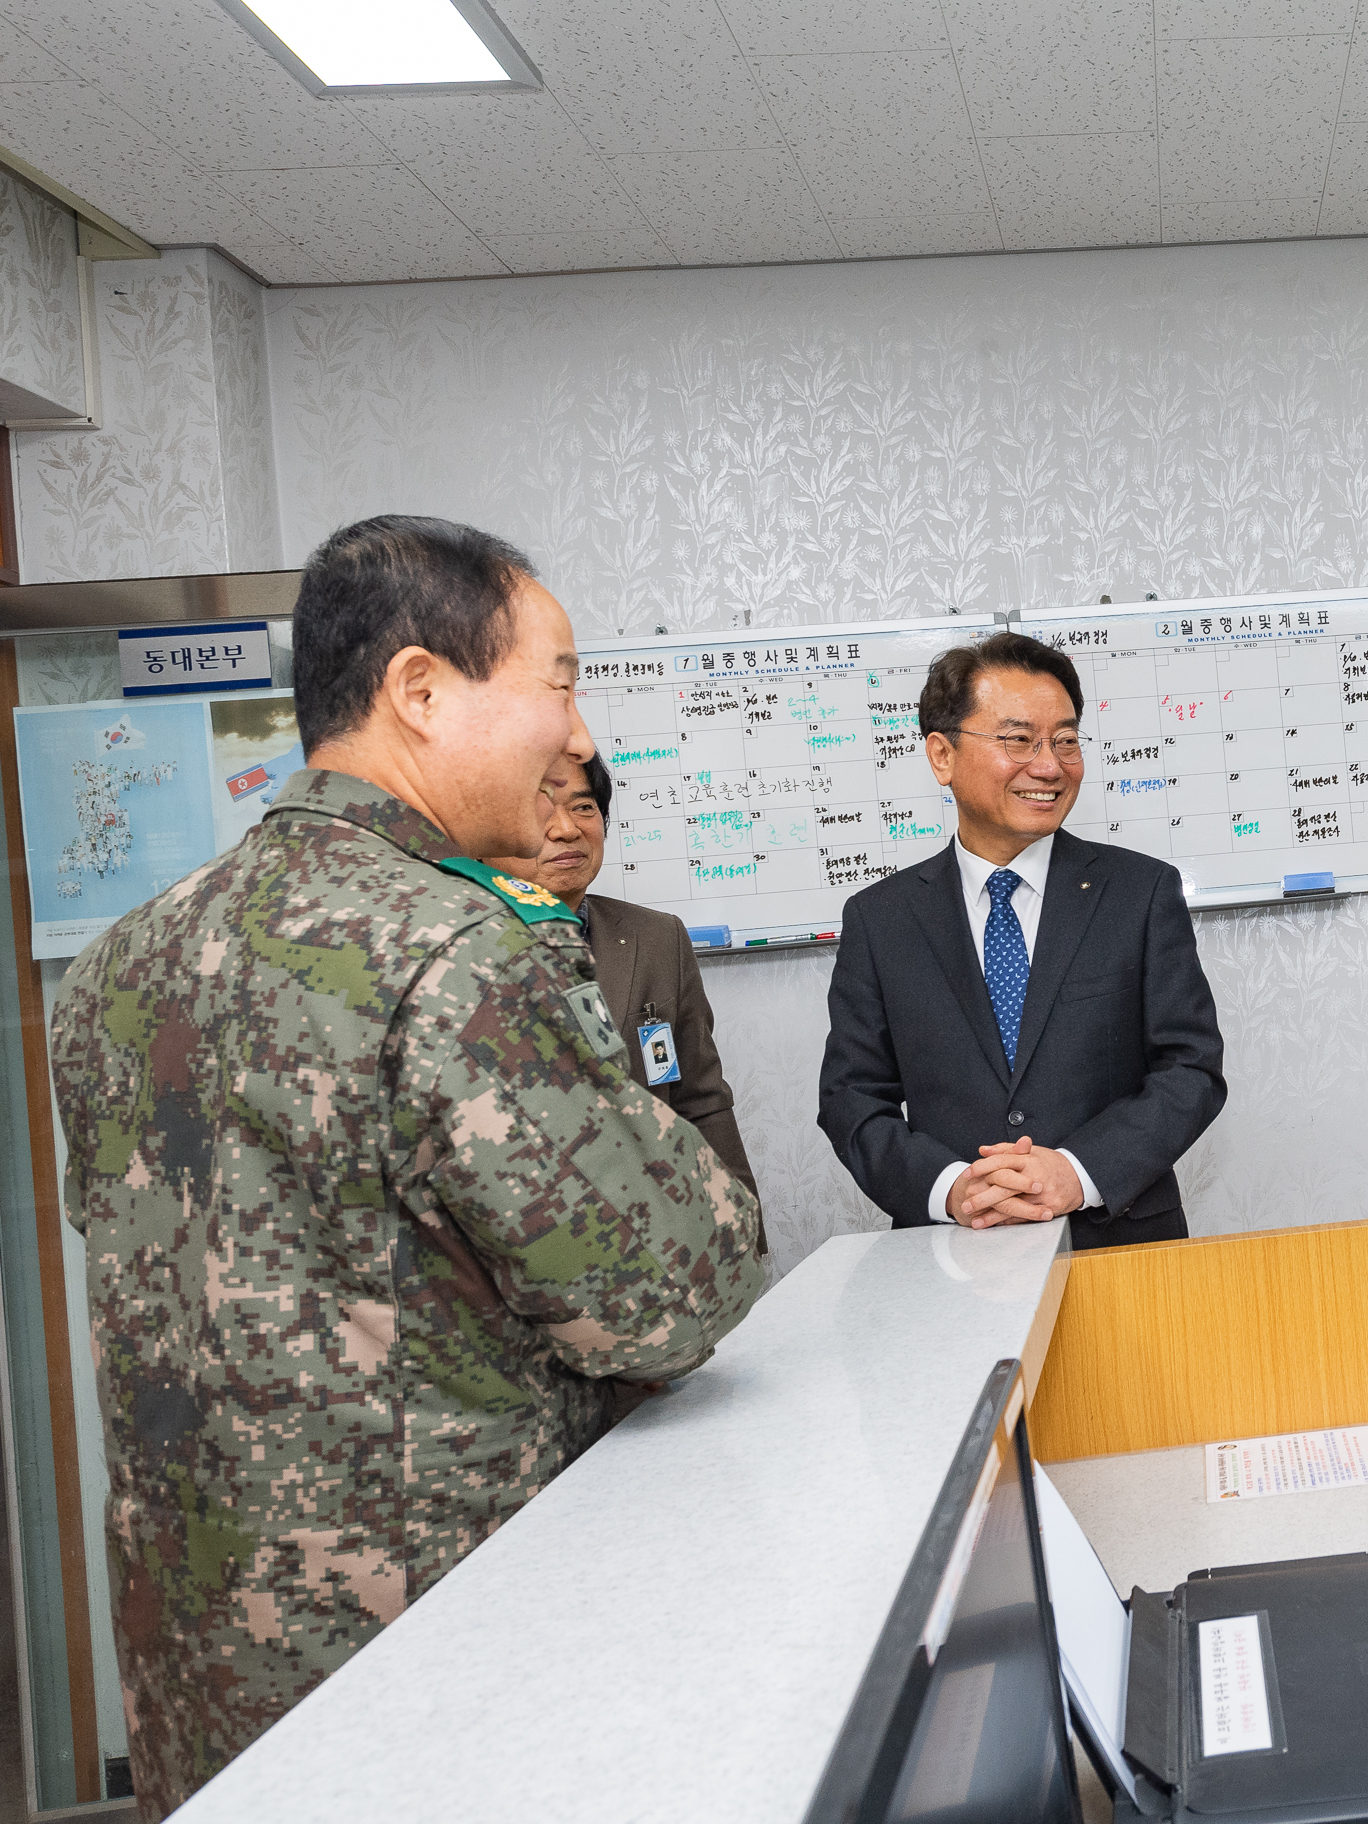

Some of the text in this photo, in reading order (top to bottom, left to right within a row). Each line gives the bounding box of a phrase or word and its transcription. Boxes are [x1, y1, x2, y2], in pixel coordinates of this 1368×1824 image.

[1161, 624, 1170, 635] 2
[1188, 635, 1226, 643] MONTHLY
[1230, 632, 1273, 640] SCHEDULE
[1340, 642, 1346, 652] 1
[142, 644, 247, 674] 동대본부
[683, 657, 690, 670] 1
[708, 670, 749, 678] MONTHLY
[755, 666, 800, 674] SCHEDULE
[815, 662, 856, 670] PLANNER
[1343, 682, 1350, 692] 8
[1223, 690, 1232, 701] 6
[746, 728, 752, 736] 9
[1344, 723, 1355, 732] 15
[681, 732, 687, 741] 8
[1164, 737, 1175, 745] 12
[1103, 741, 1112, 750] 11
[1287, 768, 1299, 777] 21
[1348, 764, 1359, 772] 22
[749, 770, 757, 778] 16
[1229, 773, 1240, 781] 20
[1167, 777, 1177, 786] 19
[1170, 817, 1182, 826] 26
[1231, 813, 1242, 822] 27
[1109, 823, 1120, 832] 25
[819, 848, 828, 856] 31
